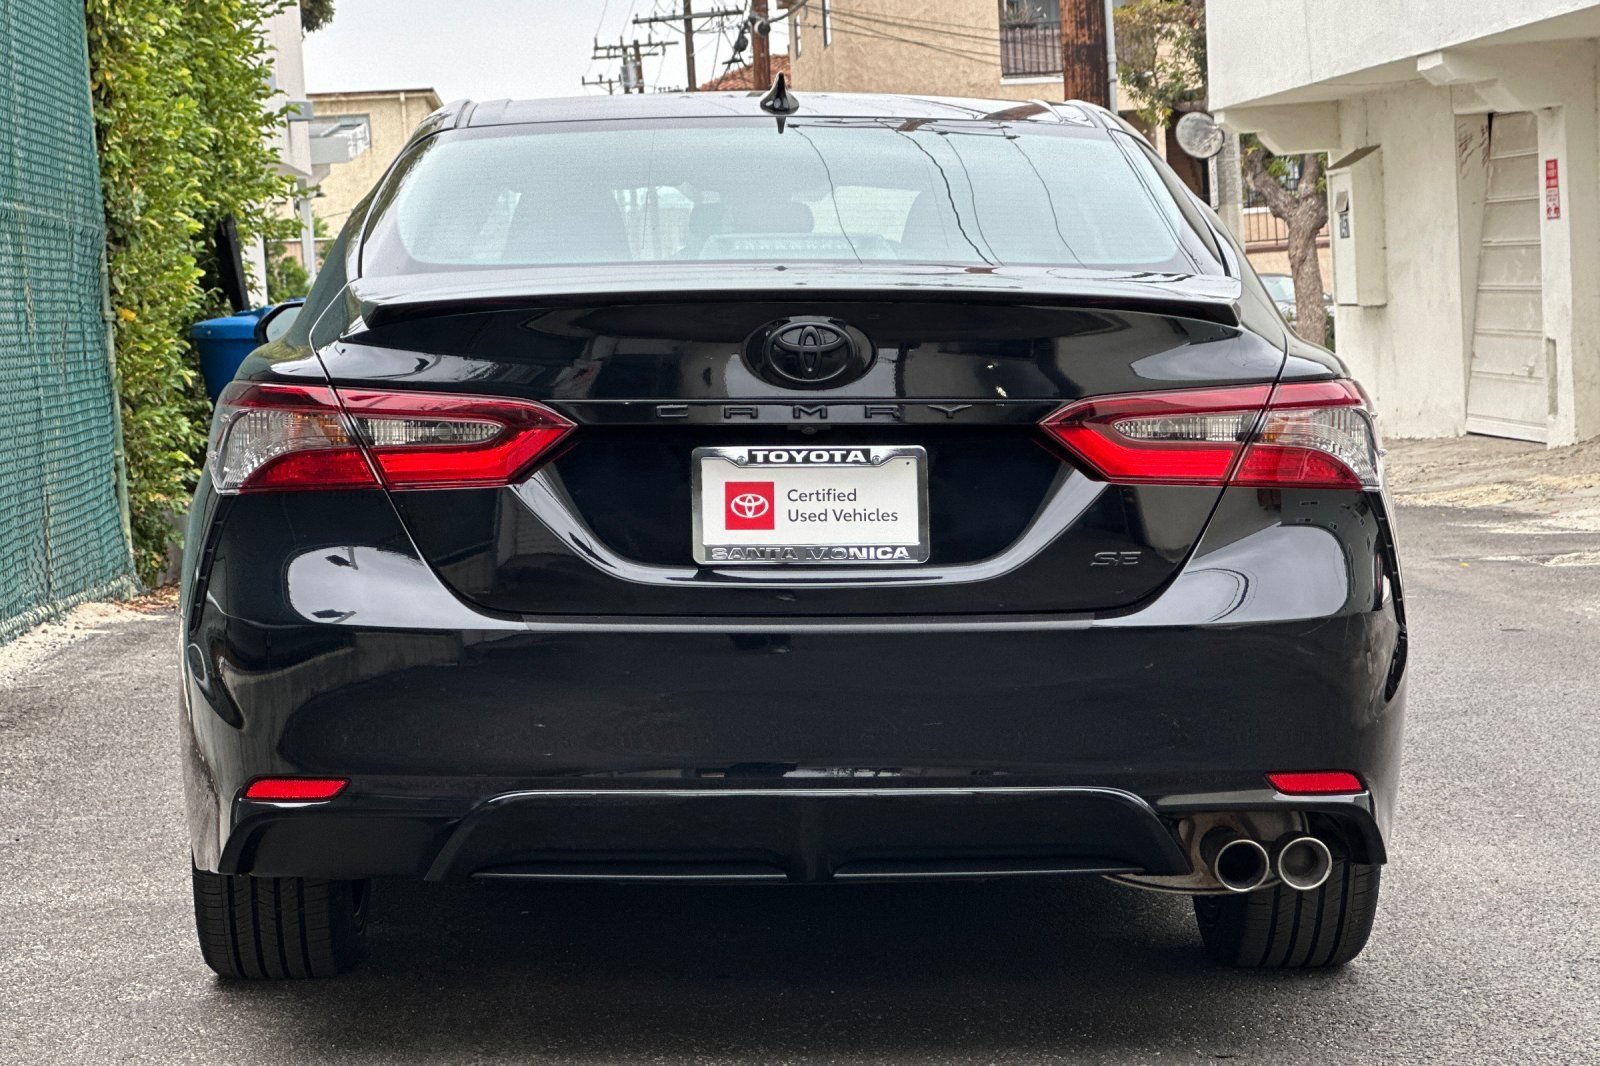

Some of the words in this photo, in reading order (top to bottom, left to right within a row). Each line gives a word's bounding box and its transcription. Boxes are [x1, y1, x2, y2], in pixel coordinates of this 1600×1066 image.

[656, 404, 973, 419] CAMRY
[751, 450, 867, 463] TOYOTA
[787, 488, 857, 502] Certified
[787, 508, 828, 522] Used
[832, 508, 898, 522] Vehicles
[711, 547, 799, 560] SANTA
[805, 546, 911, 560] MONICA
[1090, 551, 1142, 566] SE
